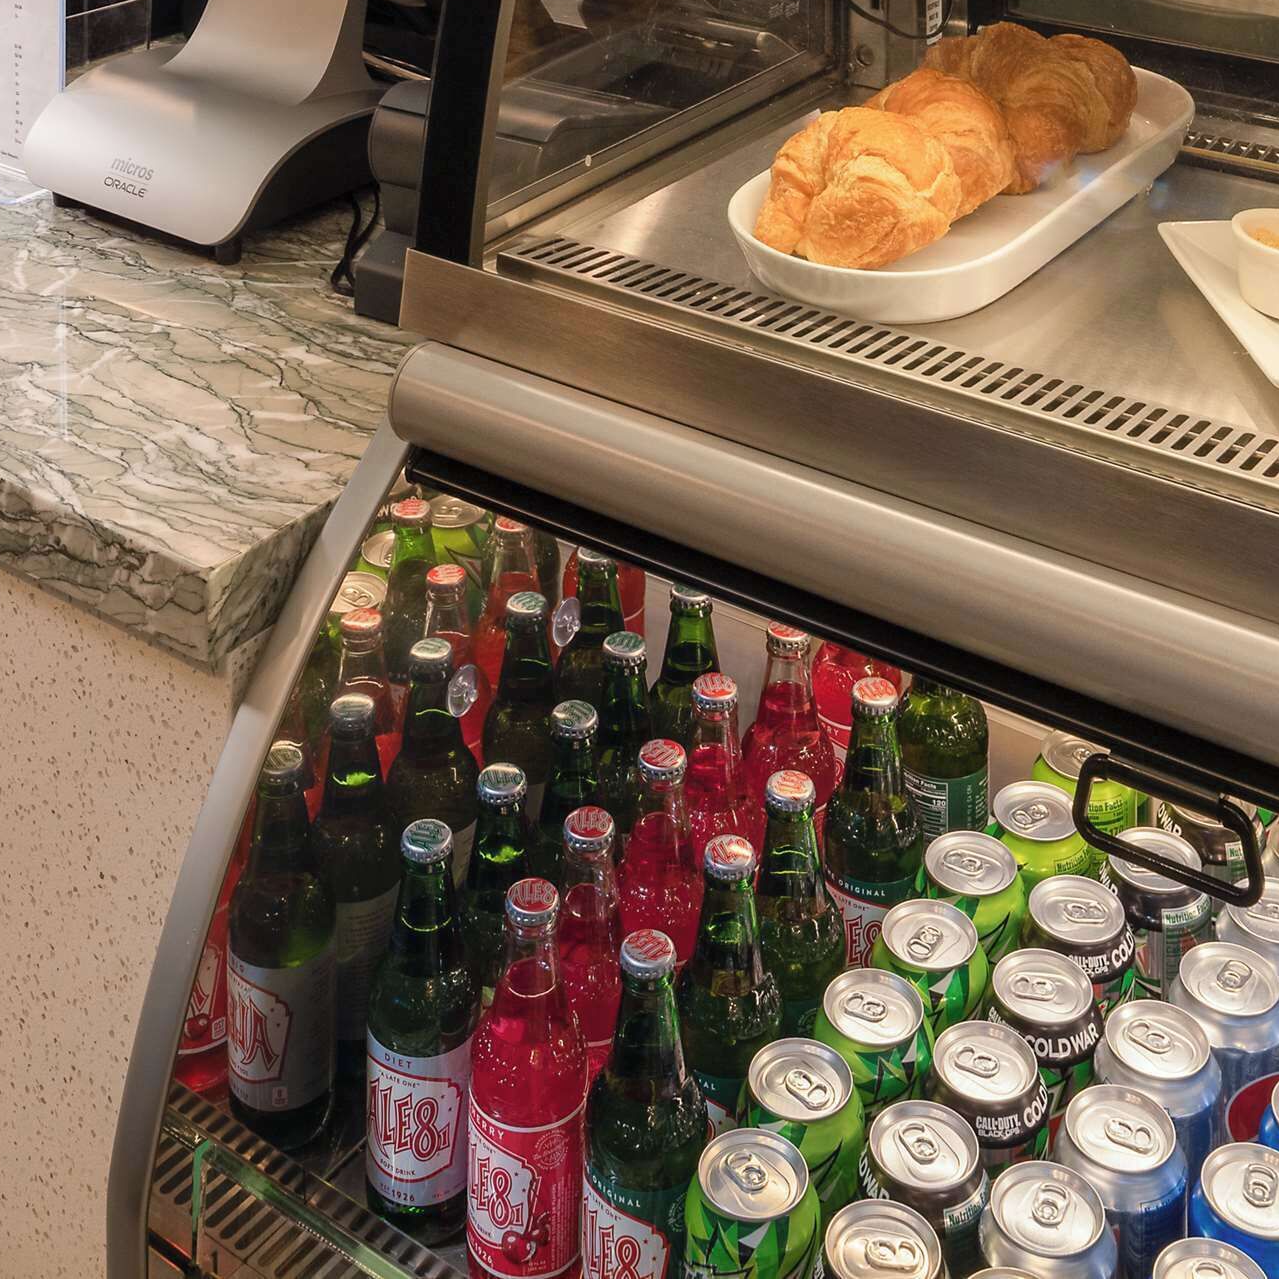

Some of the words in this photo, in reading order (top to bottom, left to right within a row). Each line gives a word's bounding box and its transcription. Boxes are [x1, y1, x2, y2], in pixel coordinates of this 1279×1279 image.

[111, 157, 154, 181] micros
[104, 176, 148, 198] ORACLE
[932, 799, 946, 807] 120
[510, 880, 554, 907] ALE8
[838, 879, 886, 897] ORIGINAL
[1111, 931, 1134, 969] COLD
[1024, 1034, 1071, 1058] COLD
[1070, 1023, 1100, 1054] WAR
[383, 1053, 412, 1070] DIET
[1023, 1080, 1048, 1127] COLD
[395, 1167, 416, 1176] DRINK
[391, 1189, 415, 1202] 1926
[592, 1175, 641, 1208] ORIGINAL
[474, 1242, 493, 1264] 1926
